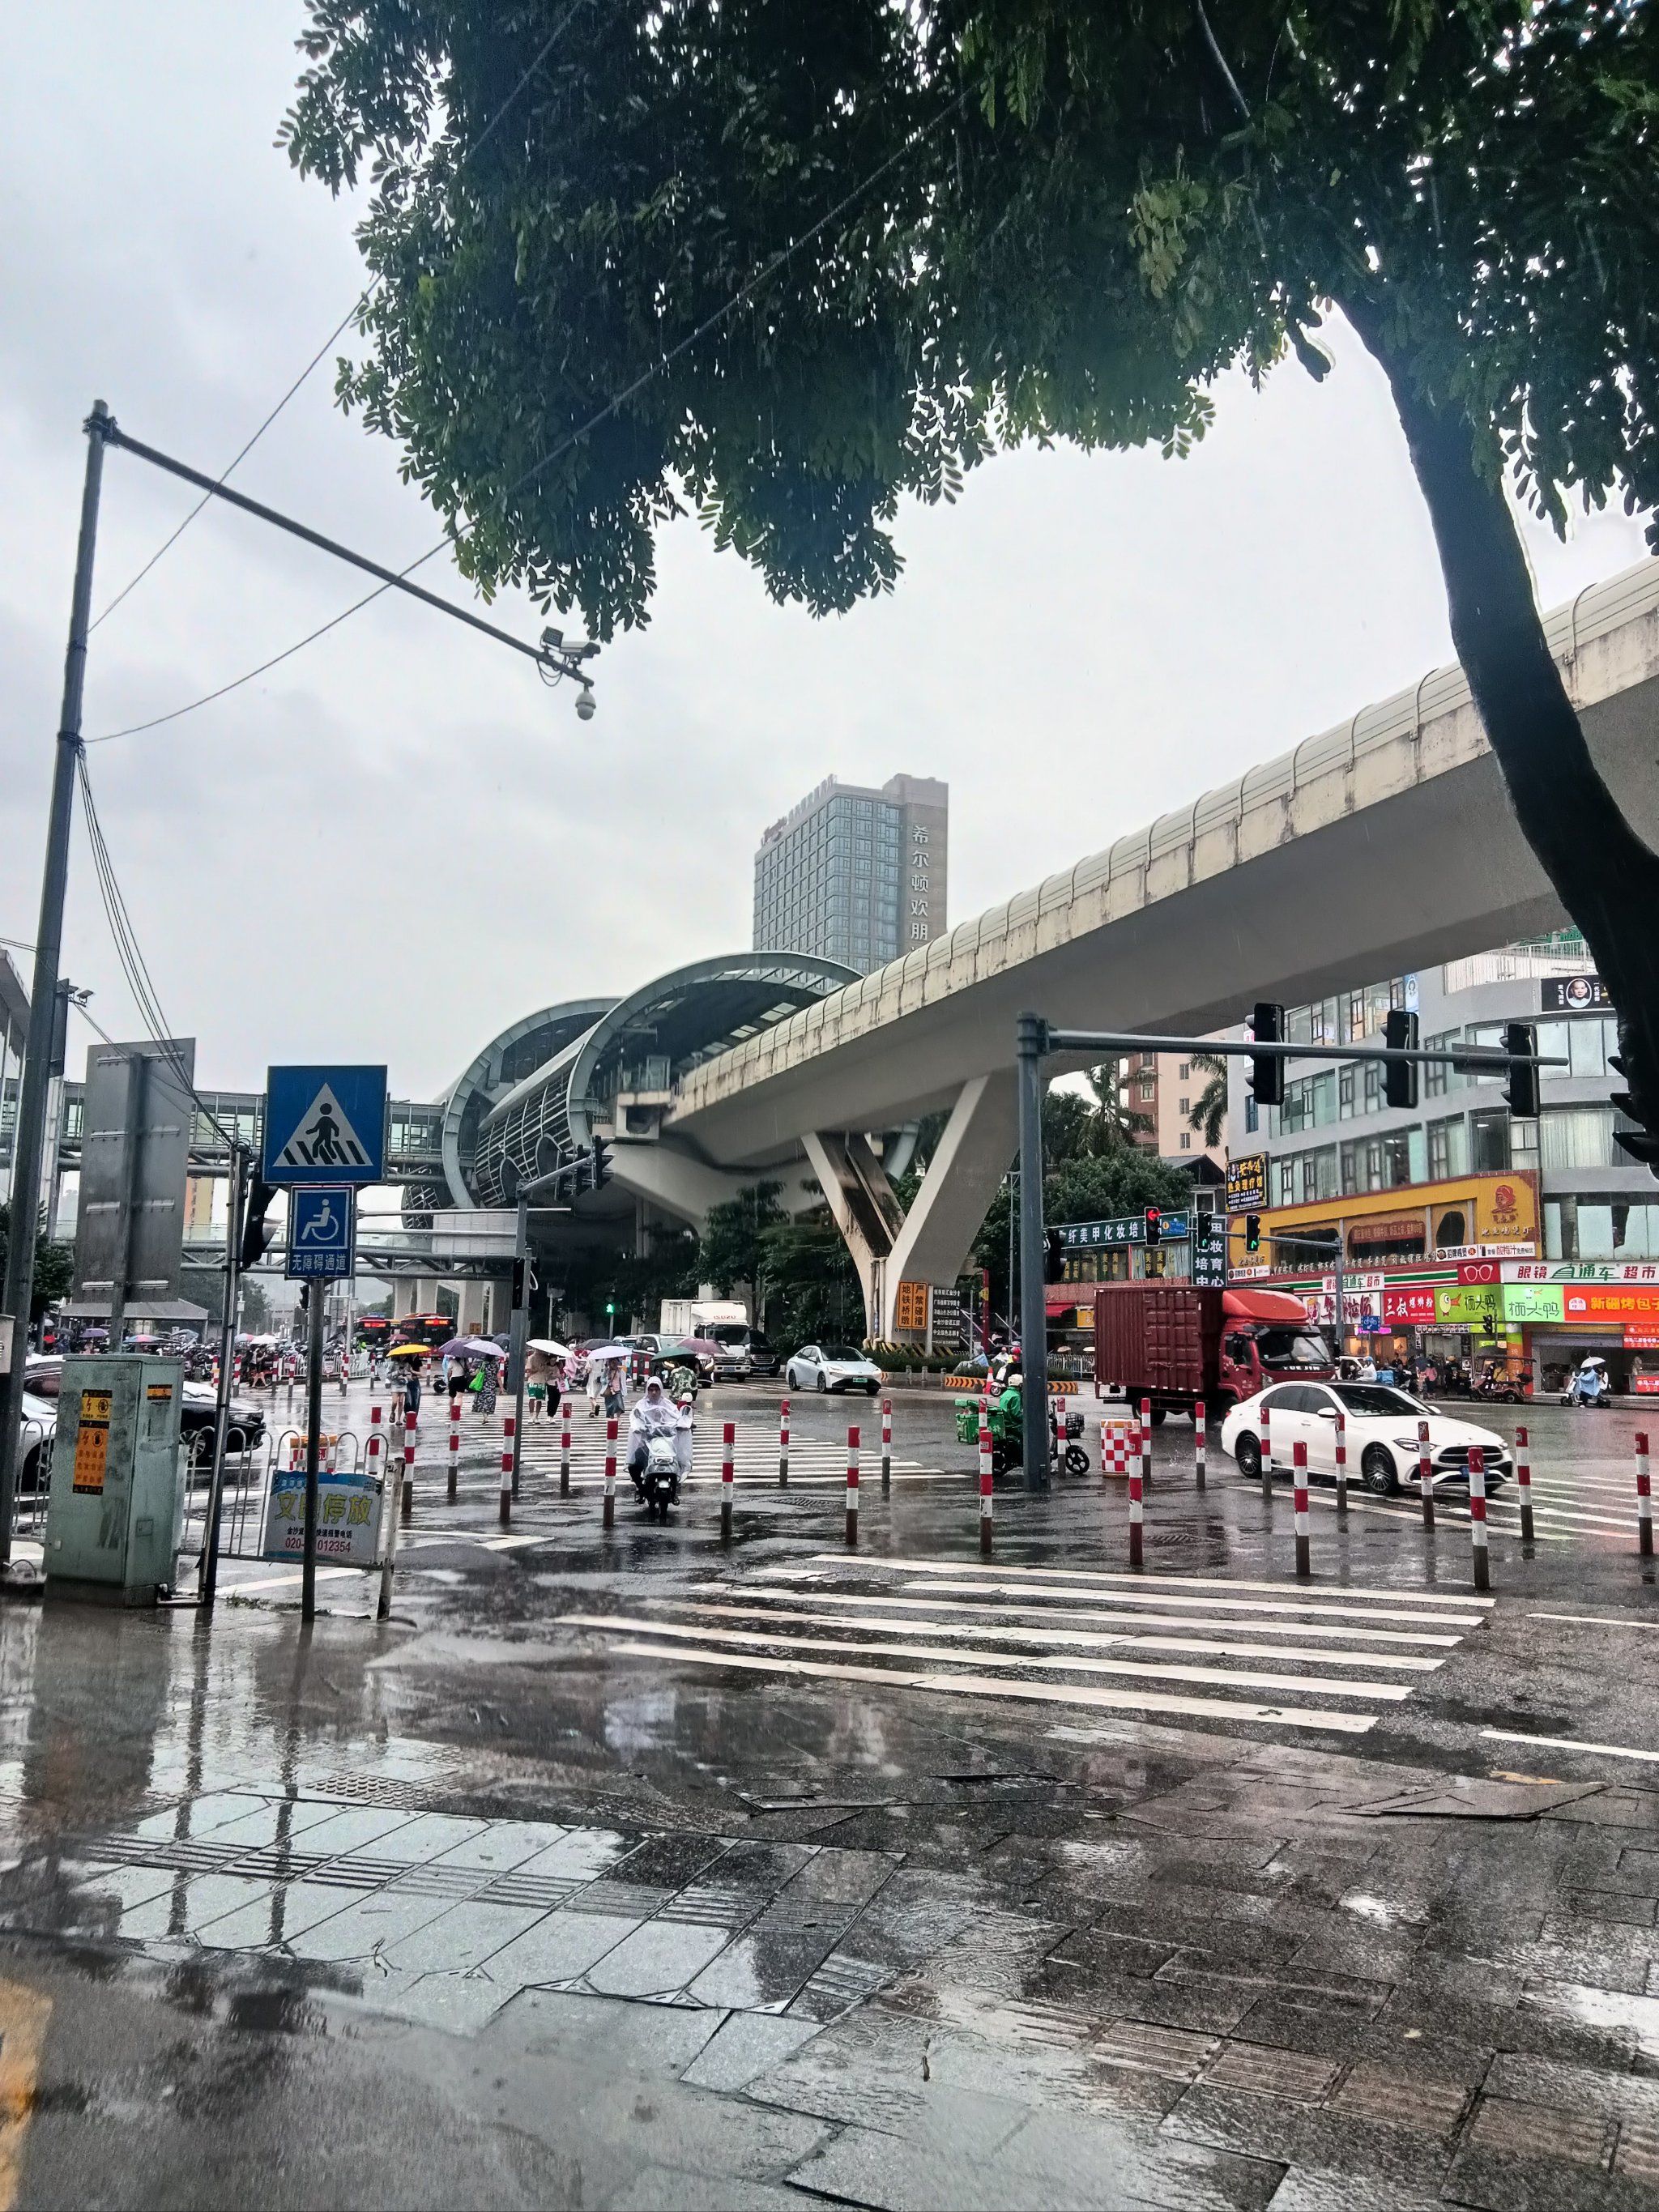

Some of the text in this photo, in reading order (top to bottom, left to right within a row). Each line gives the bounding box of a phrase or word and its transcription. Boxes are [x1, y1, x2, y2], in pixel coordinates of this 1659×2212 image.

[911, 825, 929, 953] 希尔顿欢朋
[292, 1254, 346, 1271] 无障碍通道
[1195, 1257, 1223, 1271] 培育
[1517, 1263, 1657, 1281] 眼镜直通车超市
[1196, 1275, 1224, 1287] 中心
[915, 1285, 924, 1326] 严禁碰撞
